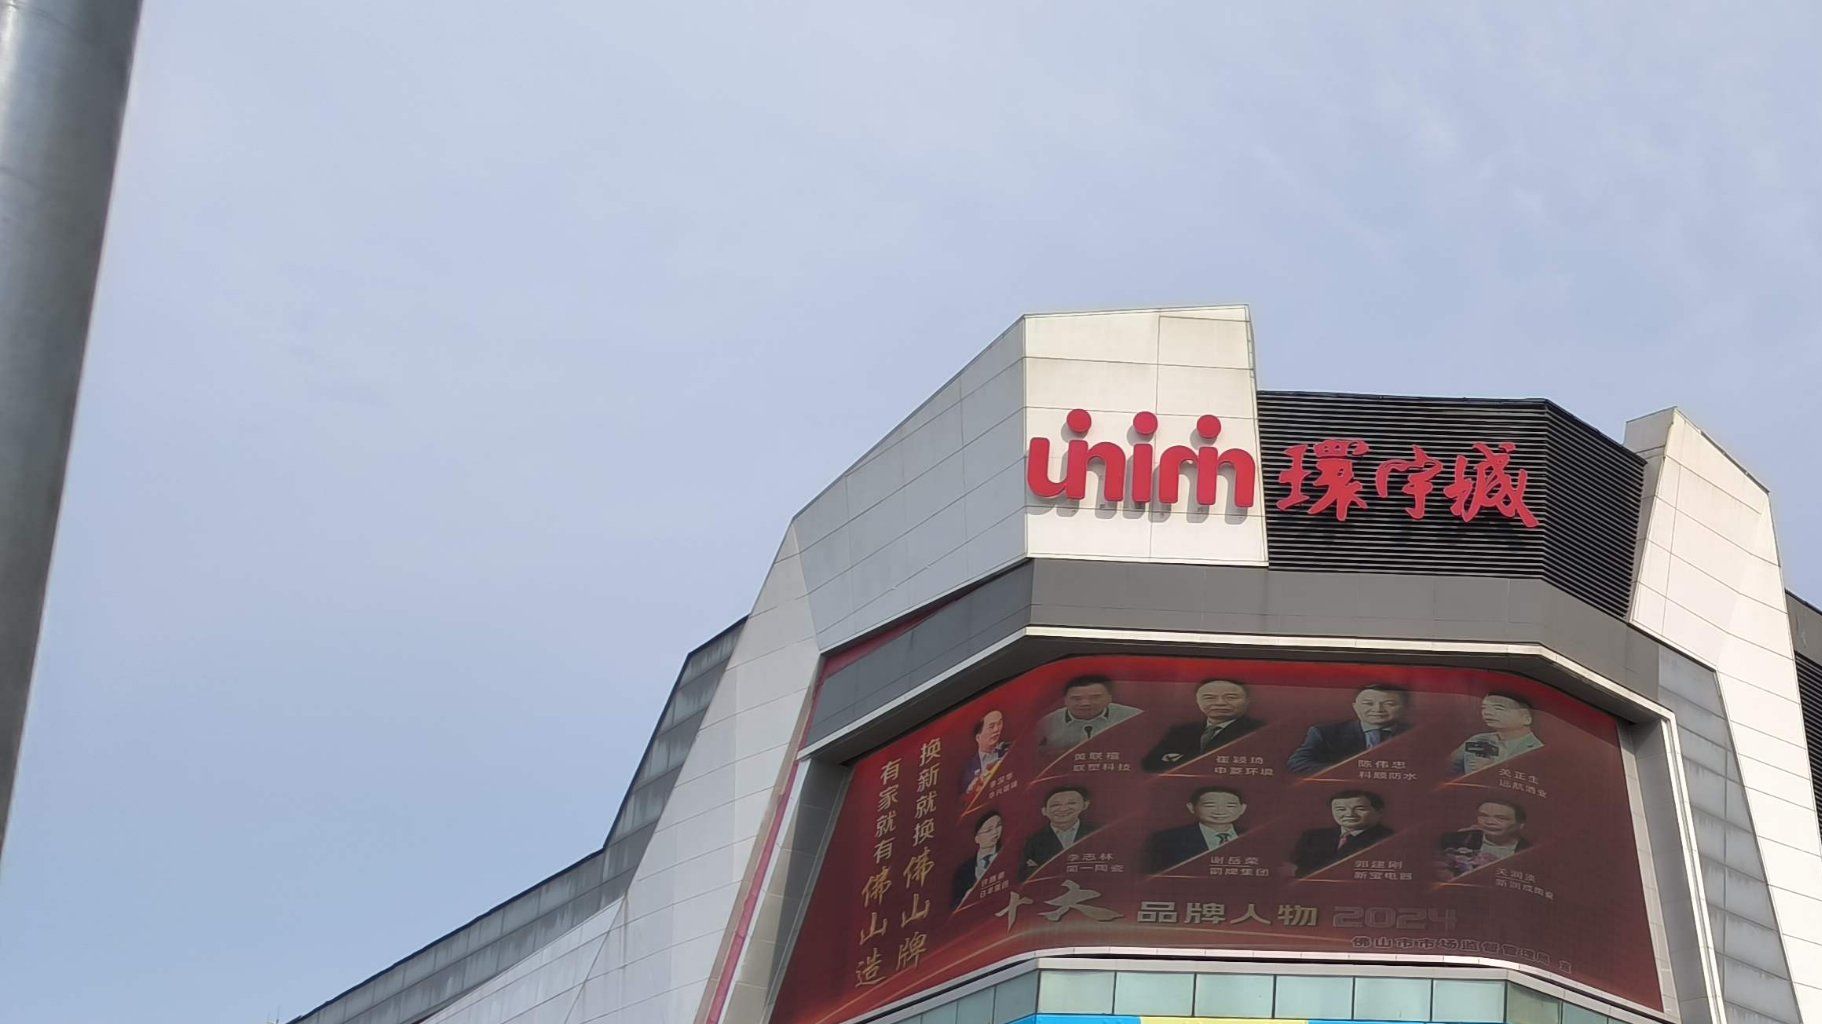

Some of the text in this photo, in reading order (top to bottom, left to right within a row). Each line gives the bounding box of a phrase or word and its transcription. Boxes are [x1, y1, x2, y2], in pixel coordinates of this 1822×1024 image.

[855, 758, 901, 989] 有家就有佛山造
[896, 738, 941, 972] 换新就换佛山牌
[1332, 905, 1457, 930] 2024
